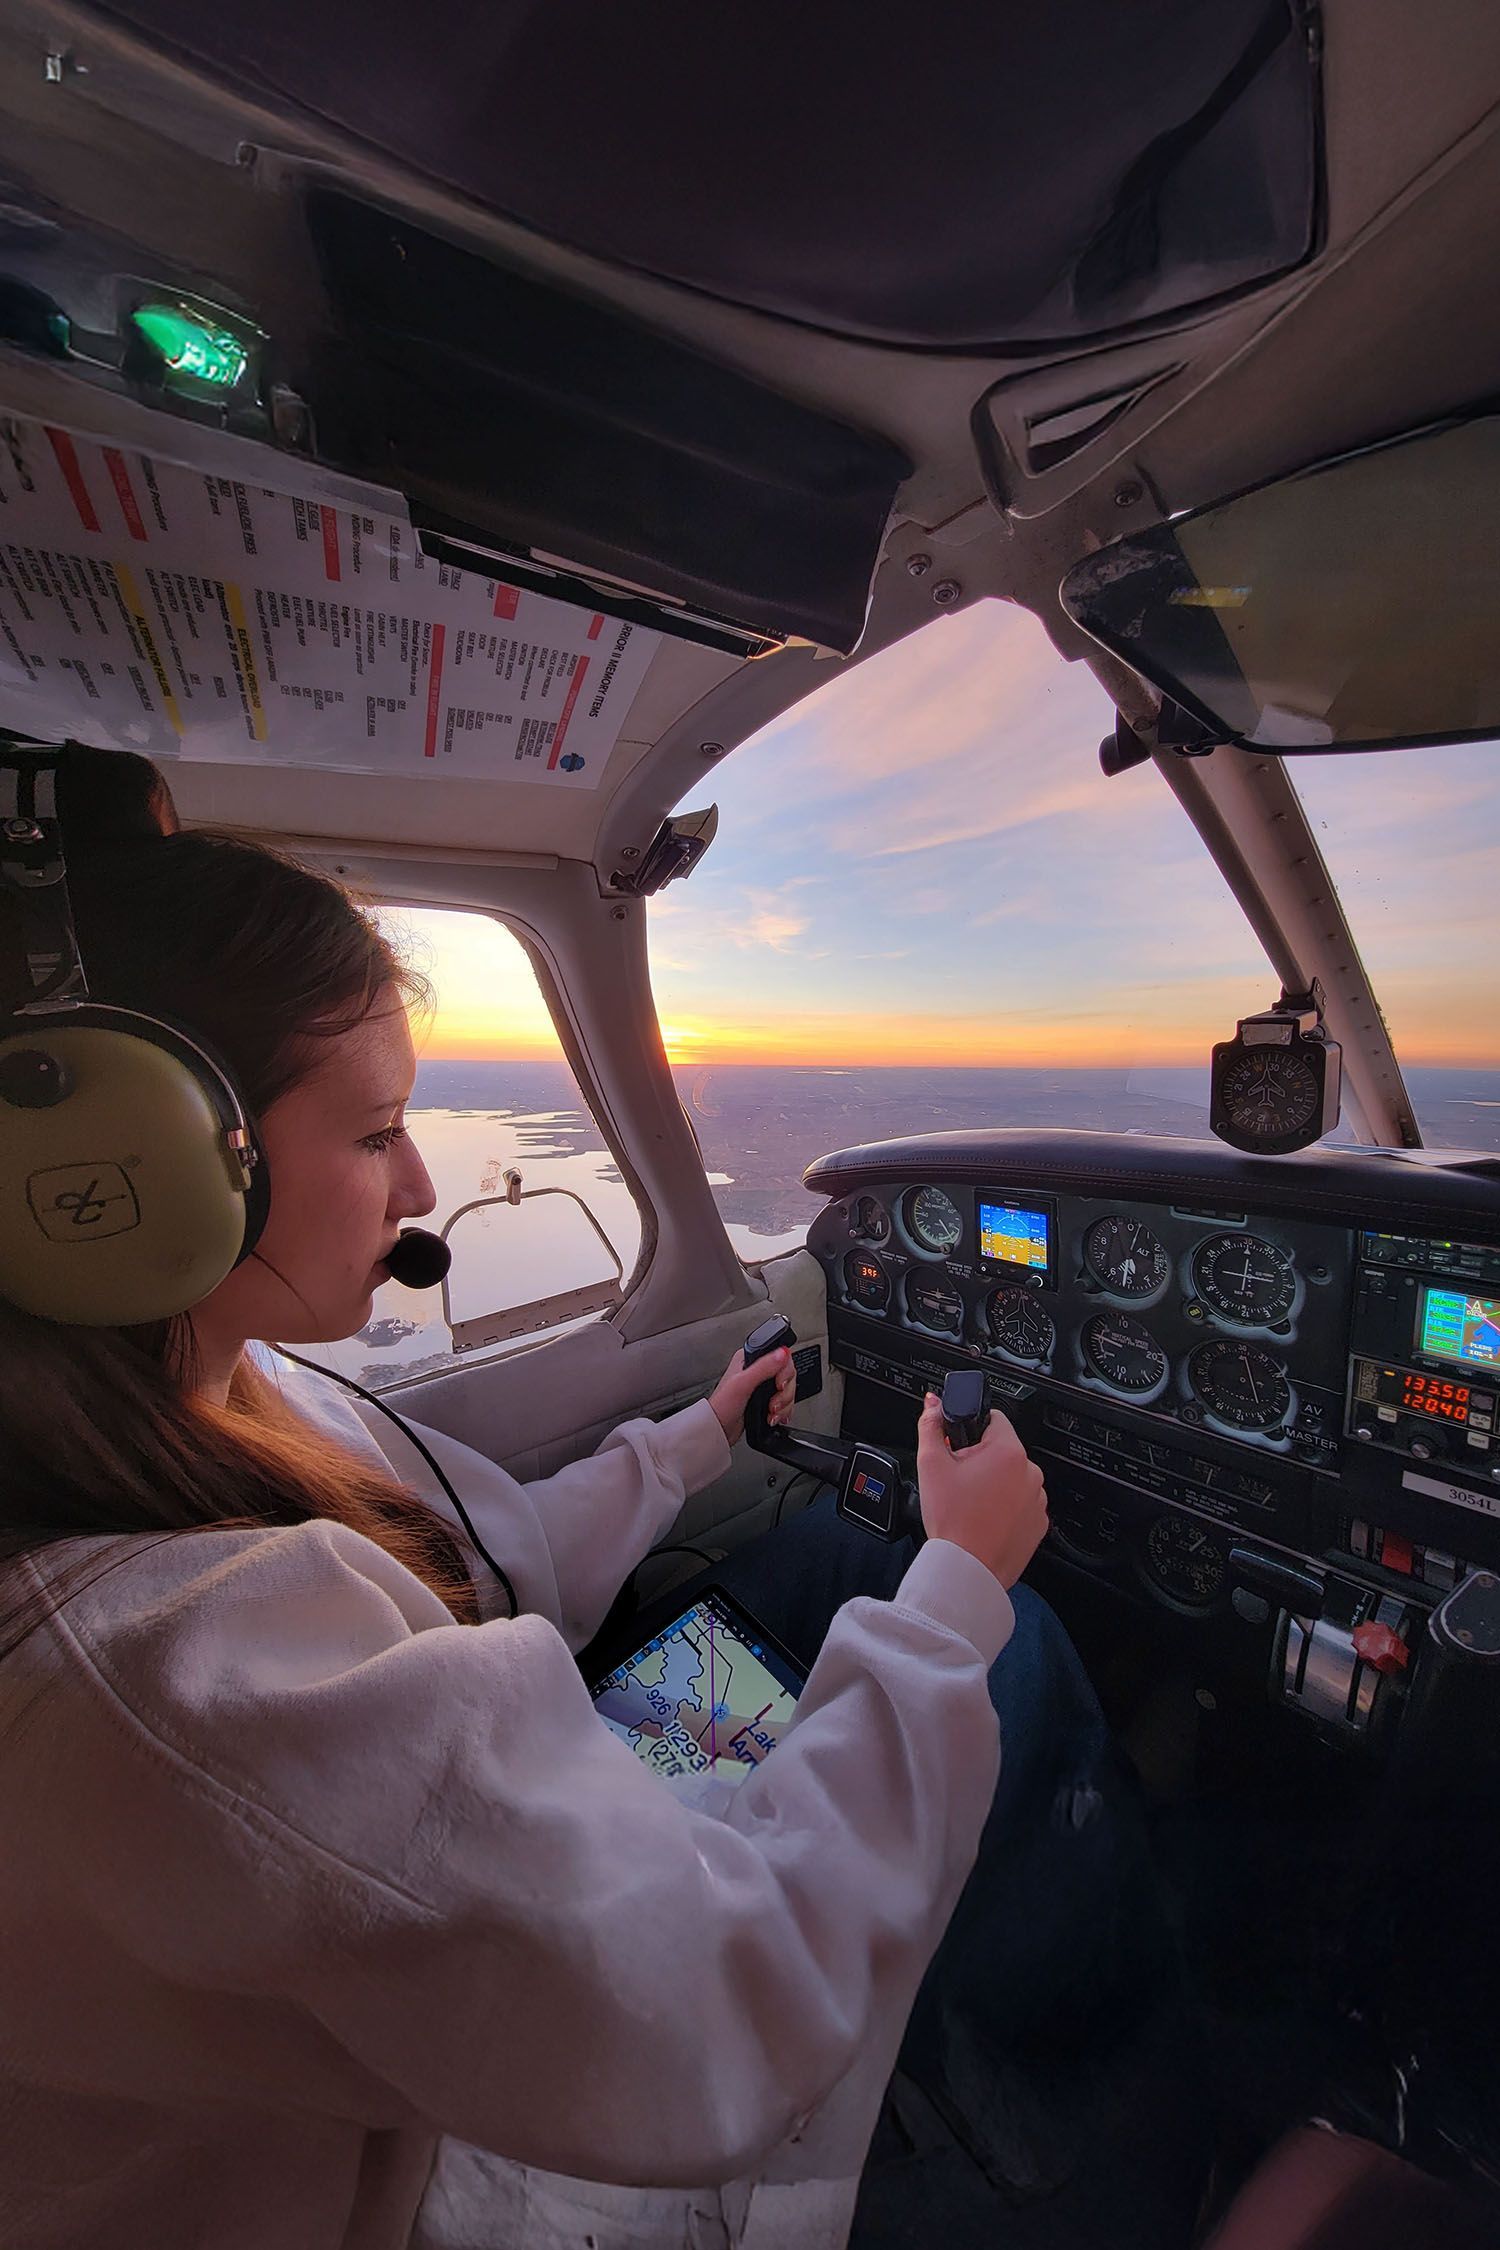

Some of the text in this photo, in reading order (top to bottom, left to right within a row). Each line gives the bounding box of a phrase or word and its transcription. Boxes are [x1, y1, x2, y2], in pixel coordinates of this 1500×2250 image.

[341, 606, 351, 639] Engine Fire
[389, 615, 397, 634] VENTS
[412, 620, 421, 646] Electrical
[423, 622, 432, 639] Check
[135, 615, 161, 667] ALTERNATOR
[237, 628, 253, 672] ELECTRICAL
[400, 618, 409, 663] MASTER SWITCH
[411, 645, 420, 656] Fire
[478, 634, 487, 650] DOOR
[598, 659, 618, 695] MEMORY
[589, 695, 604, 718] ITEMS
[1304, 1404, 1324, 1416] AV
[1403, 1393, 1467, 1420] 120.40
[1286, 1427, 1339, 1451] MASTER
[862, 1489, 881, 1504] PIPER
[1449, 1489, 1497, 1512] 3054L
[646, 1690, 672, 1716] 926
